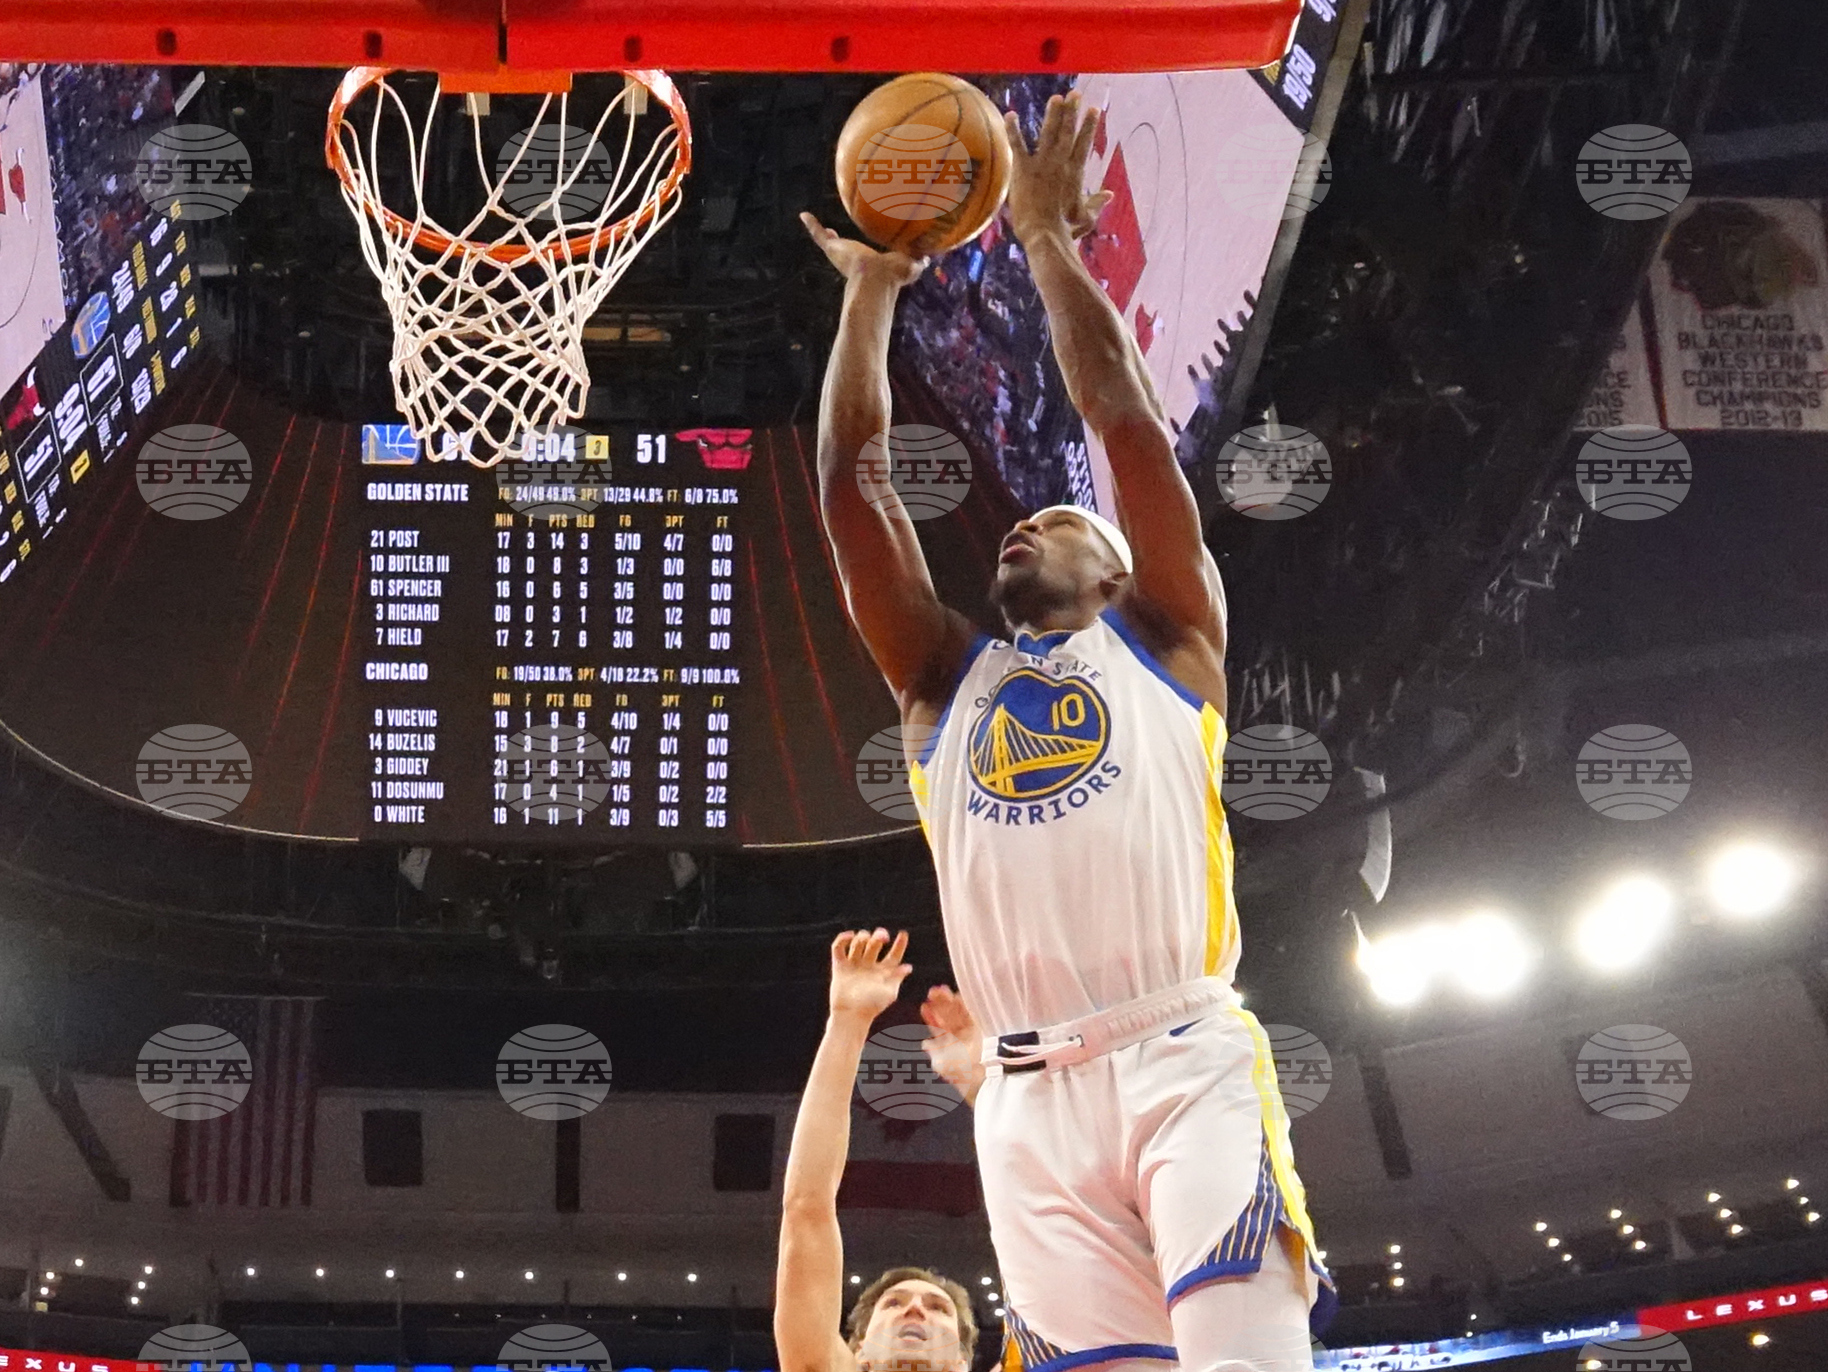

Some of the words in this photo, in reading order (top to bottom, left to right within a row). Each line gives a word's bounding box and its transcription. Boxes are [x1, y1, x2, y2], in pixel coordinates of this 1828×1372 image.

[637, 434, 666, 463] 51
[367, 483, 421, 501] GOLDEN
[425, 484, 469, 501] STATE
[371, 530, 383, 547] 21
[388, 531, 419, 547] POST
[371, 555, 384, 572] 10
[388, 555, 433, 572] BUTLER
[437, 555, 450, 572] III
[371, 579, 383, 596] 61
[388, 580, 441, 597] SPENCER
[376, 604, 383, 621] 3
[388, 604, 439, 621] RICHARD
[376, 628, 383, 645] 7
[388, 628, 422, 646] HIELD
[366, 663, 428, 680] CHICAGO
[375, 709, 383, 727] 9
[387, 709, 437, 727] VUCEVIC
[1053, 693, 1085, 730] 10
[369, 733, 382, 750] 14
[387, 734, 435, 751] BUZELIS
[375, 757, 382, 775] 3
[387, 757, 429, 775] GIDDEY
[371, 781, 382, 798] 11
[386, 782, 444, 799] DOSUNMU
[967, 760, 1122, 826] WARRIORS
[374, 805, 382, 822] 0
[386, 806, 425, 823] WHITE
[1685, 1288, 1828, 1321] LEXUS
